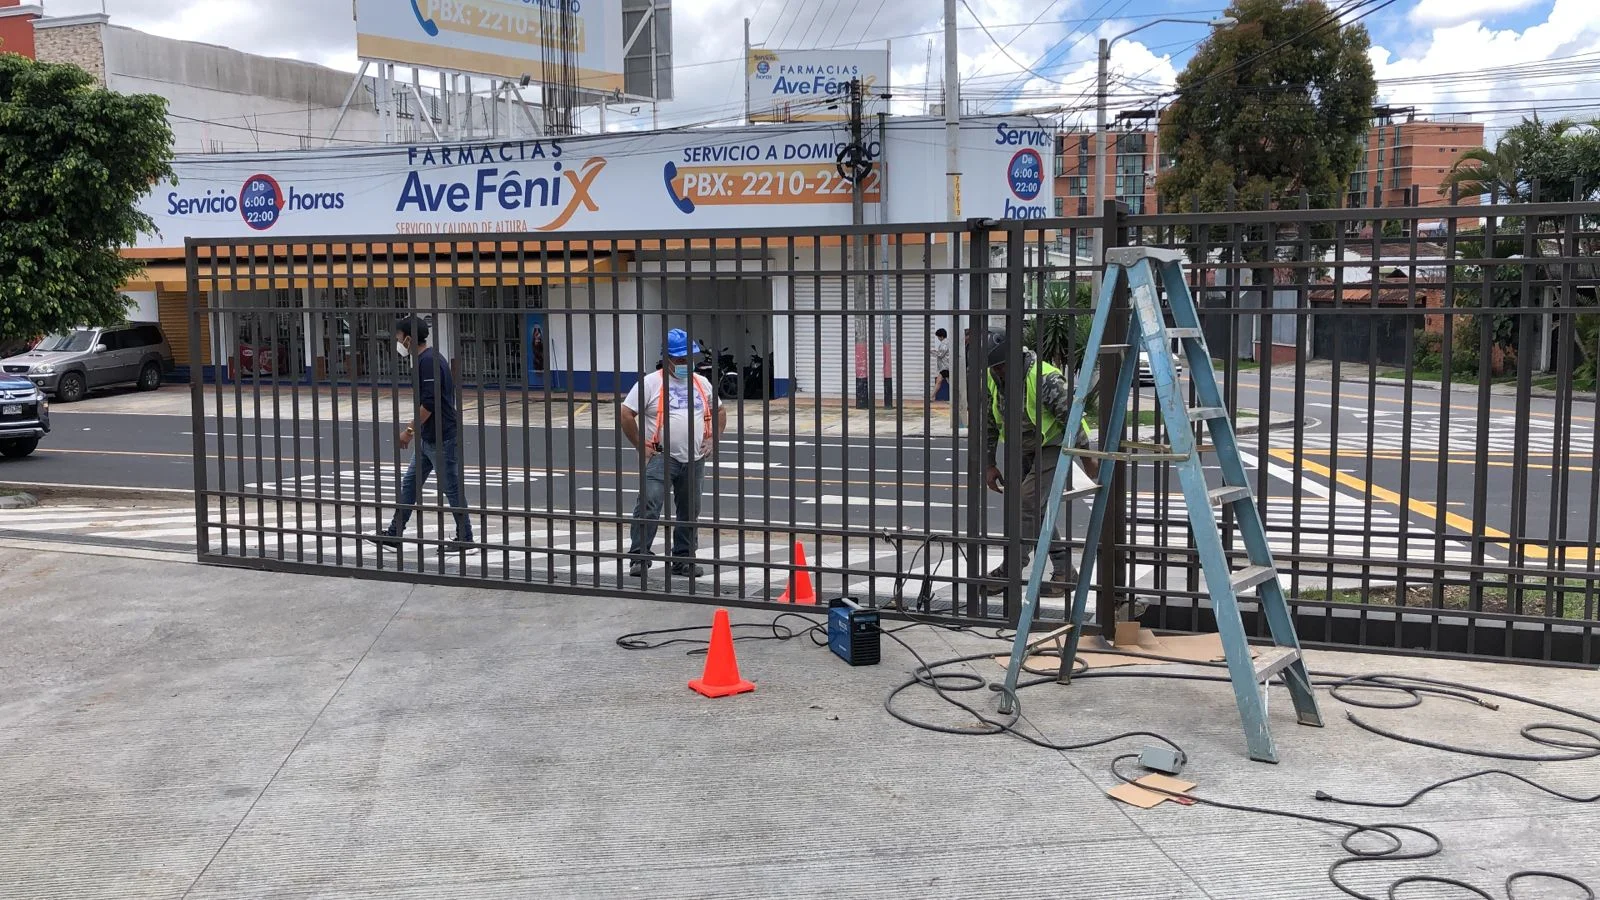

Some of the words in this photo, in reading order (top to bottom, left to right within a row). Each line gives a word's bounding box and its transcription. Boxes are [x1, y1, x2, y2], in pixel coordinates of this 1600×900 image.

[427, 1, 472, 25] PBX:
[780, 65, 858, 74] FARMACIAS
[408, 140, 562, 165] FARMACIAS
[684, 145, 760, 163] SERVICIO
[765, 145, 778, 160] A
[1021, 154, 1033, 164] De
[1014, 168, 1032, 178] 6:00
[252, 181, 265, 192] De
[682, 172, 733, 197] PBX:
[1015, 182, 1038, 193] 22:00
[167, 188, 238, 215] Servicio
[244, 197, 265, 207] 6:00
[288, 186, 345, 211] horas
[1004, 198, 1047, 220] horas
[247, 211, 274, 222] 22:00
[395, 222, 433, 234] SERVICIO
